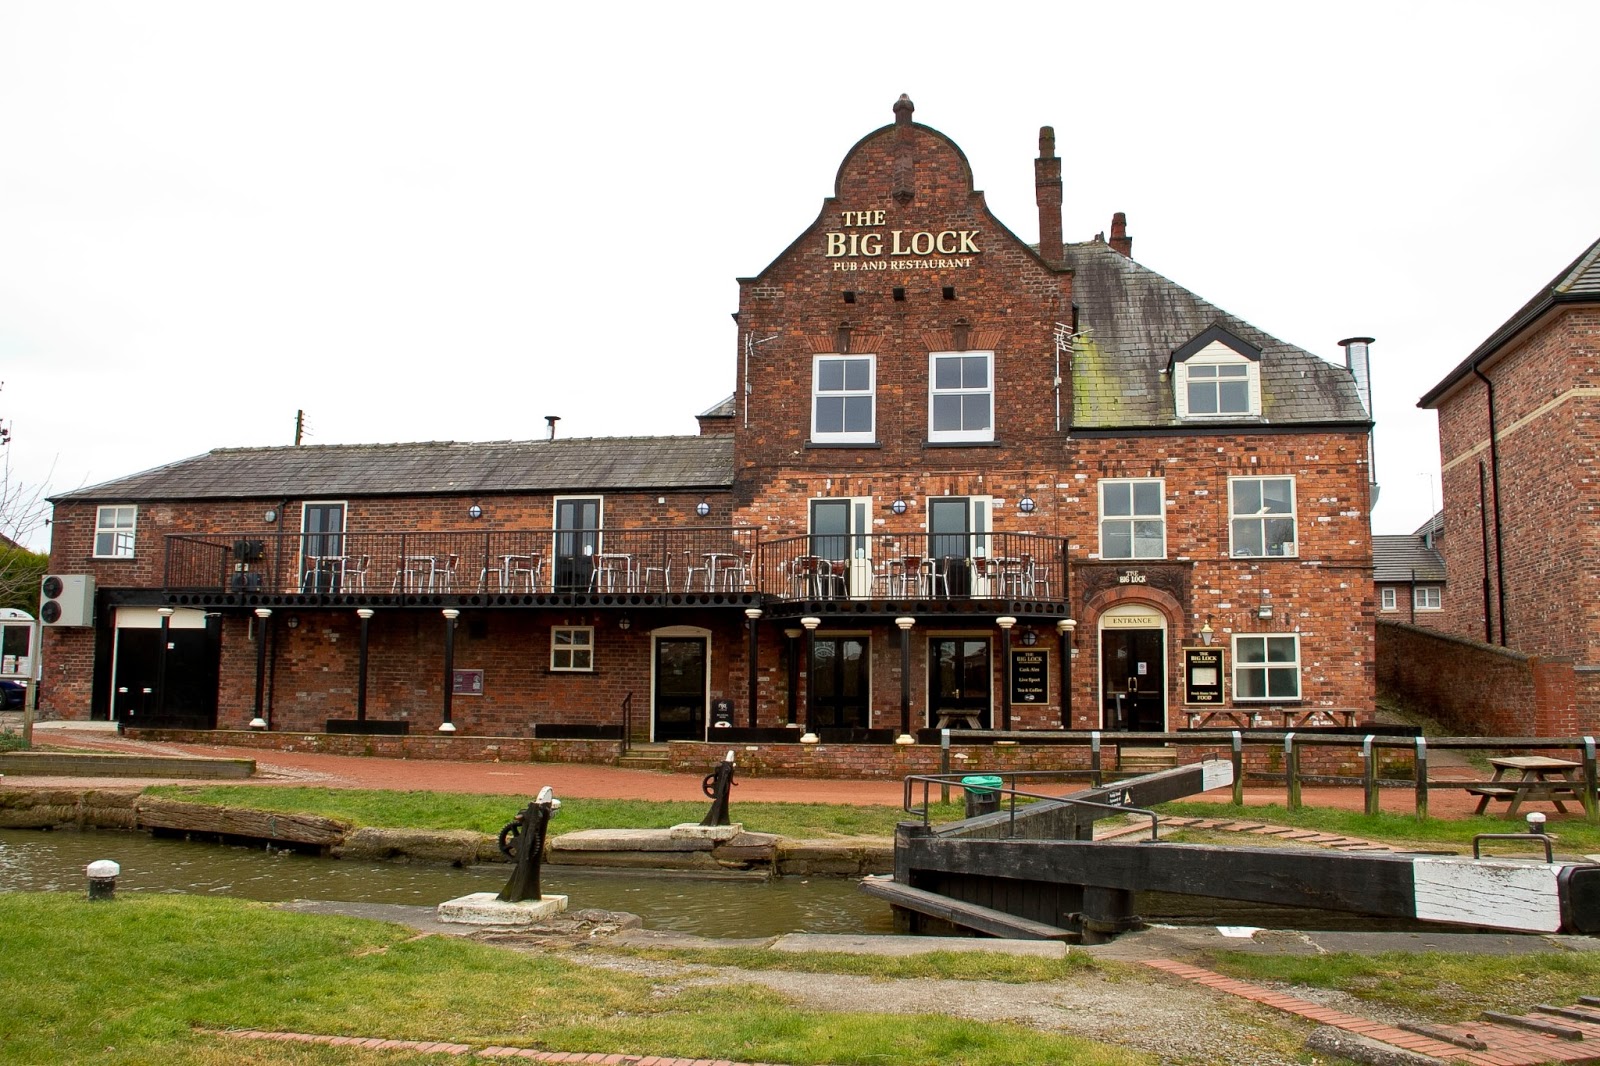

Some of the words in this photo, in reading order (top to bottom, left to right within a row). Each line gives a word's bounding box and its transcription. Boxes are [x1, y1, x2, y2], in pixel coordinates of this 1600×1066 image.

[842, 210, 886, 227] THE
[825, 232, 884, 258] BIG
[890, 230, 981, 255] LOCK
[833, 261, 857, 272] PUB
[860, 260, 887, 271] AND
[890, 258, 973, 270] RESTAURANT
[1119, 575, 1130, 583] BIG
[1131, 575, 1146, 583] LOCK
